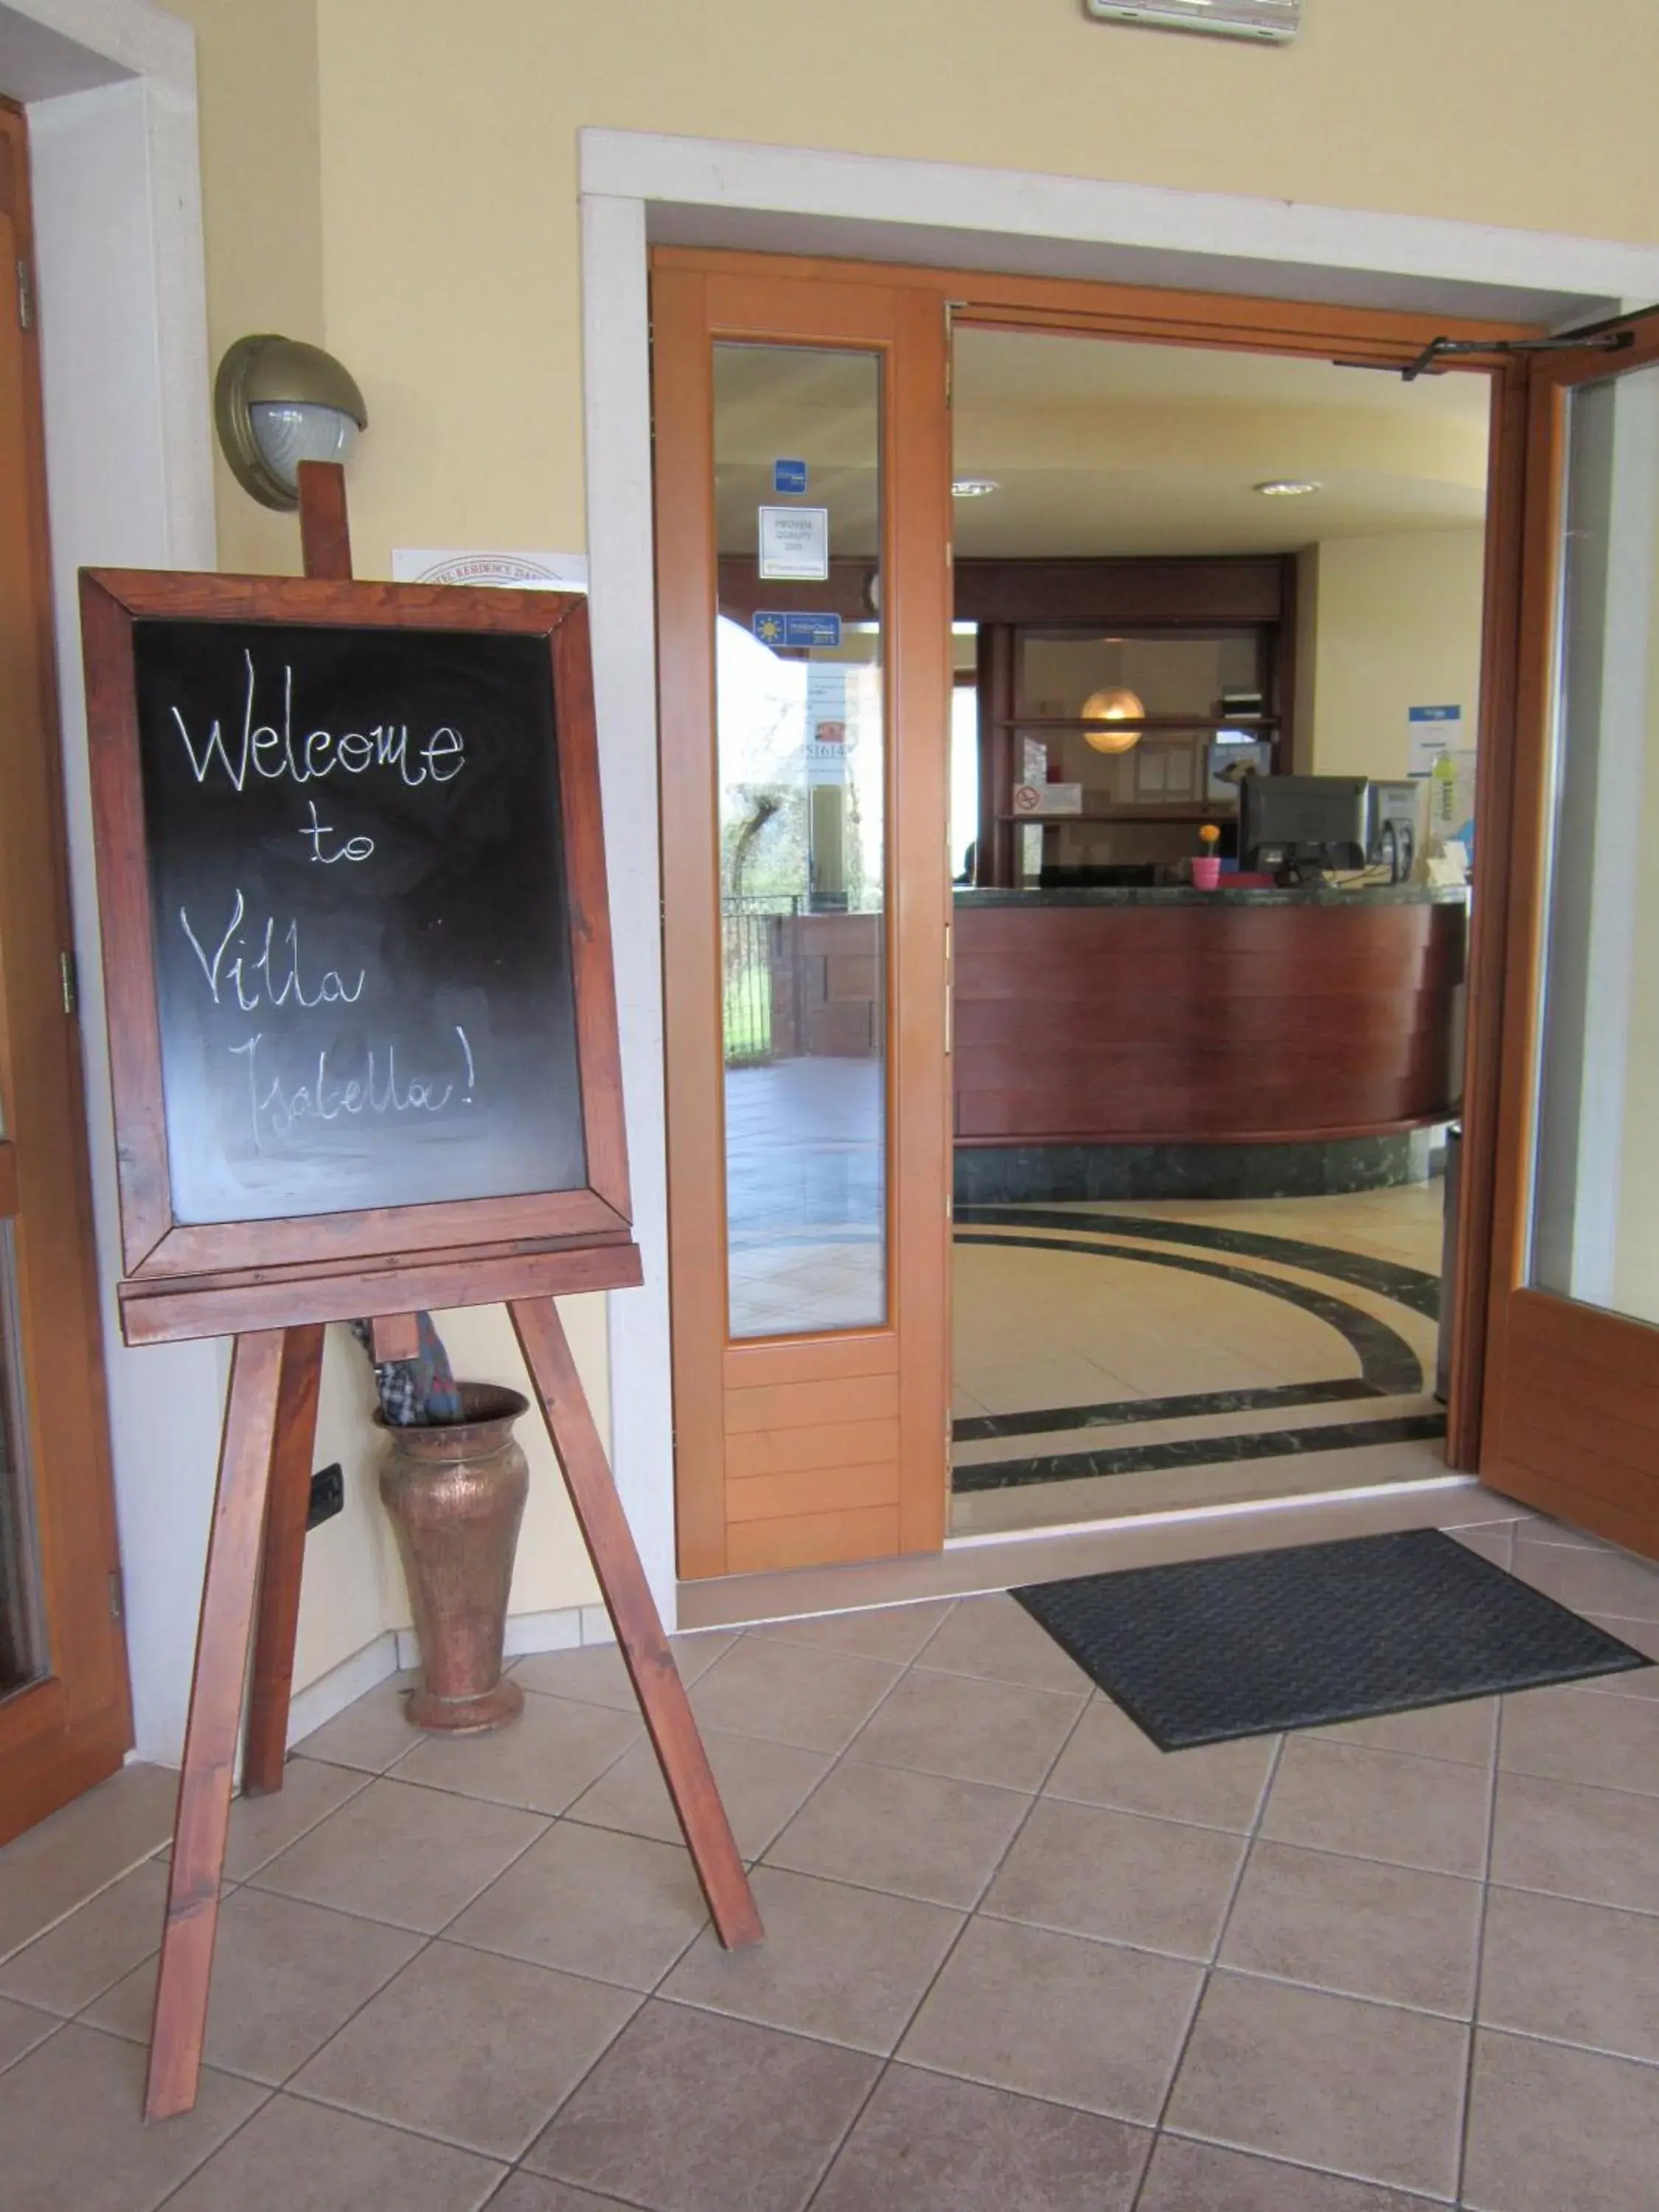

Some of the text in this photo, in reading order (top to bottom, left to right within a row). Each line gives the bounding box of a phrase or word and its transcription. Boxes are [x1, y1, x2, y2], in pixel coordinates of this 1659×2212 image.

[456, 563, 511, 577] RESIDENCE
[172, 649, 465, 791] Welcome
[299, 801, 375, 863] to
[180, 888, 365, 1011] Villa
[229, 1026, 476, 1155] Isabella!
